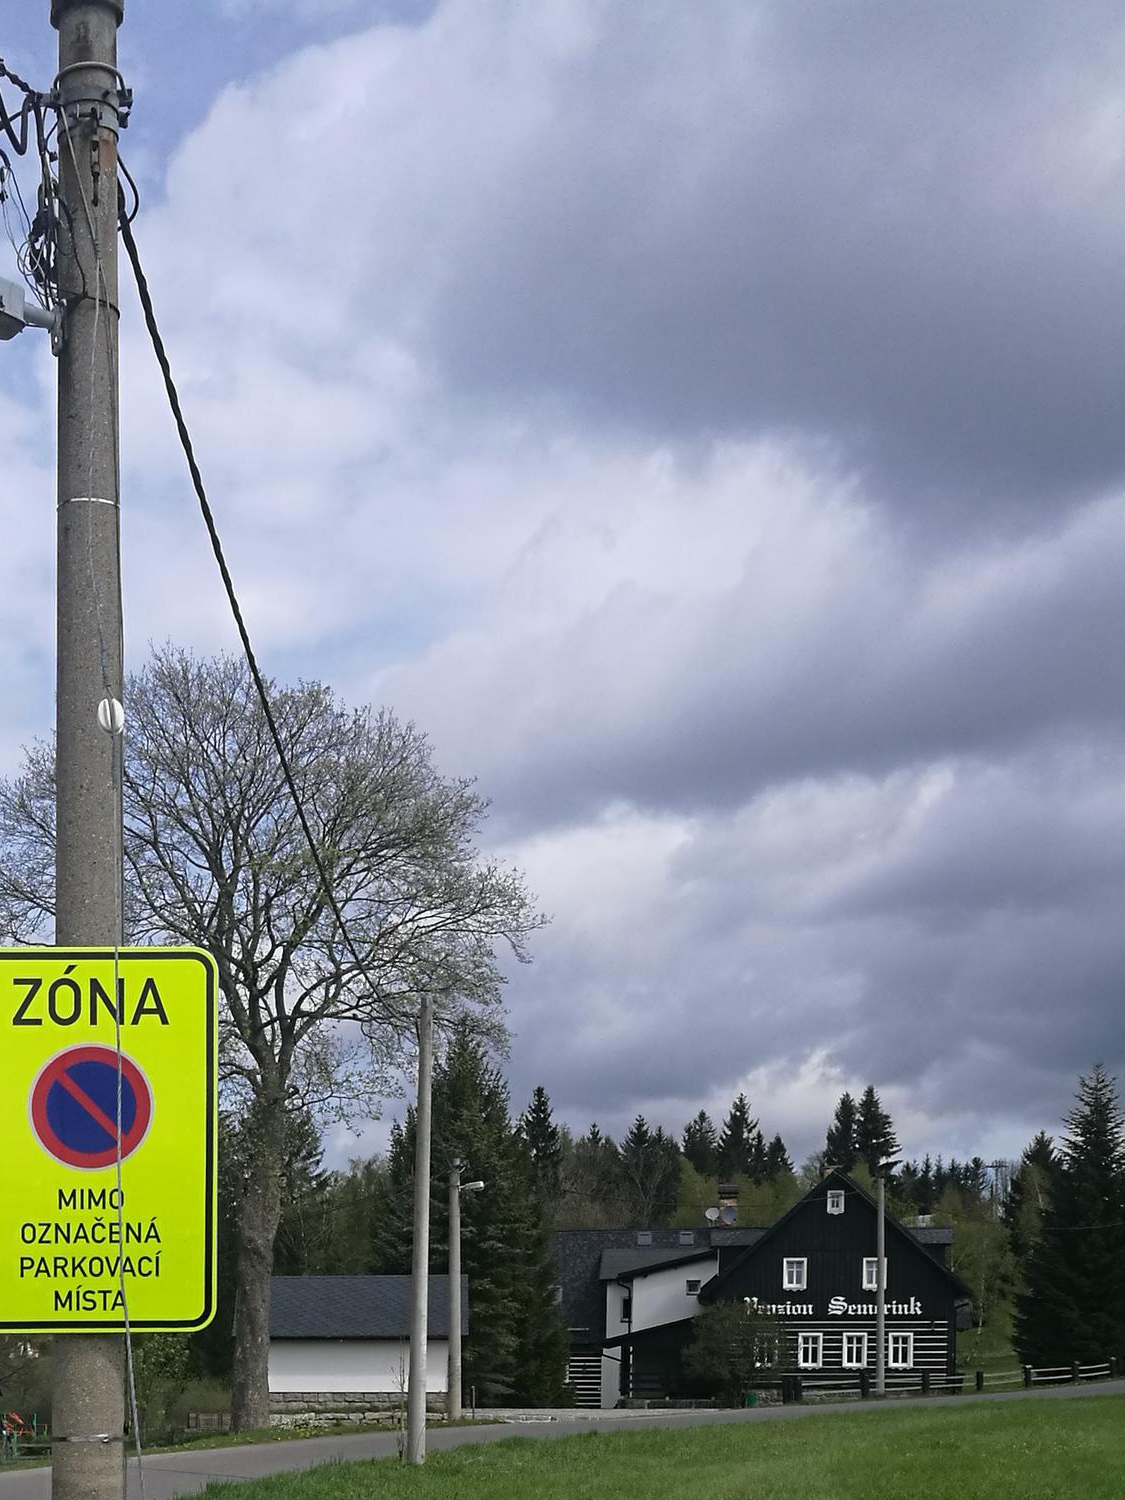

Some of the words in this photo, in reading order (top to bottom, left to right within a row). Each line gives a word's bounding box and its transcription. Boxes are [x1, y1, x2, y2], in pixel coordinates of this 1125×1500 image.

[11, 963, 170, 1027] ZÓNA
[57, 1187, 124, 1210] MIMO
[20, 1216, 162, 1244] OZNAČENÁ
[19, 1250, 162, 1278] PARKOVACÍ
[53, 1285, 126, 1312] MÍSTA
